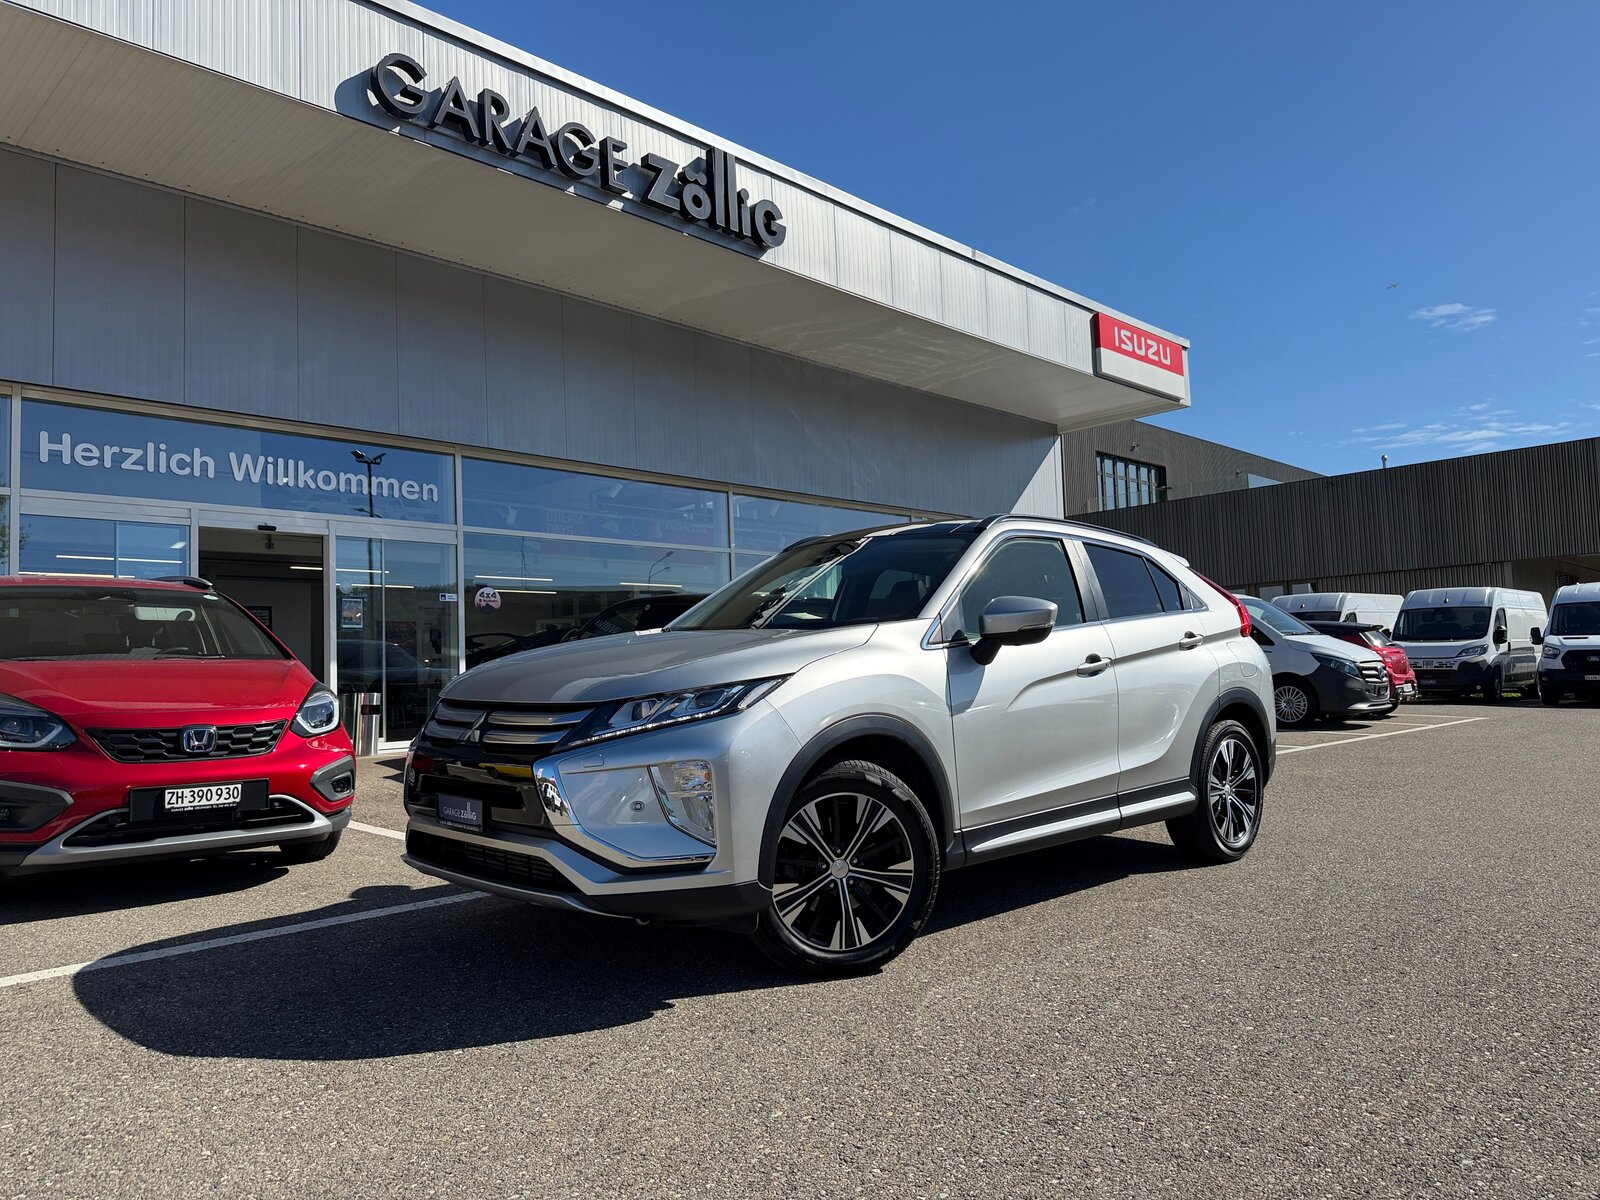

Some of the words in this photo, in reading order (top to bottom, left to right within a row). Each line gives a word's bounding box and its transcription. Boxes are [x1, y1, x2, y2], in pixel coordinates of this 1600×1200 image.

[369, 53, 632, 195] GARAGE
[1114, 326, 1171, 366] ISUZU
[39, 430, 215, 479] Herzlich
[229, 451, 439, 502] Willkommen
[479, 591, 497, 599] 4x4
[215, 786, 240, 802] 930
